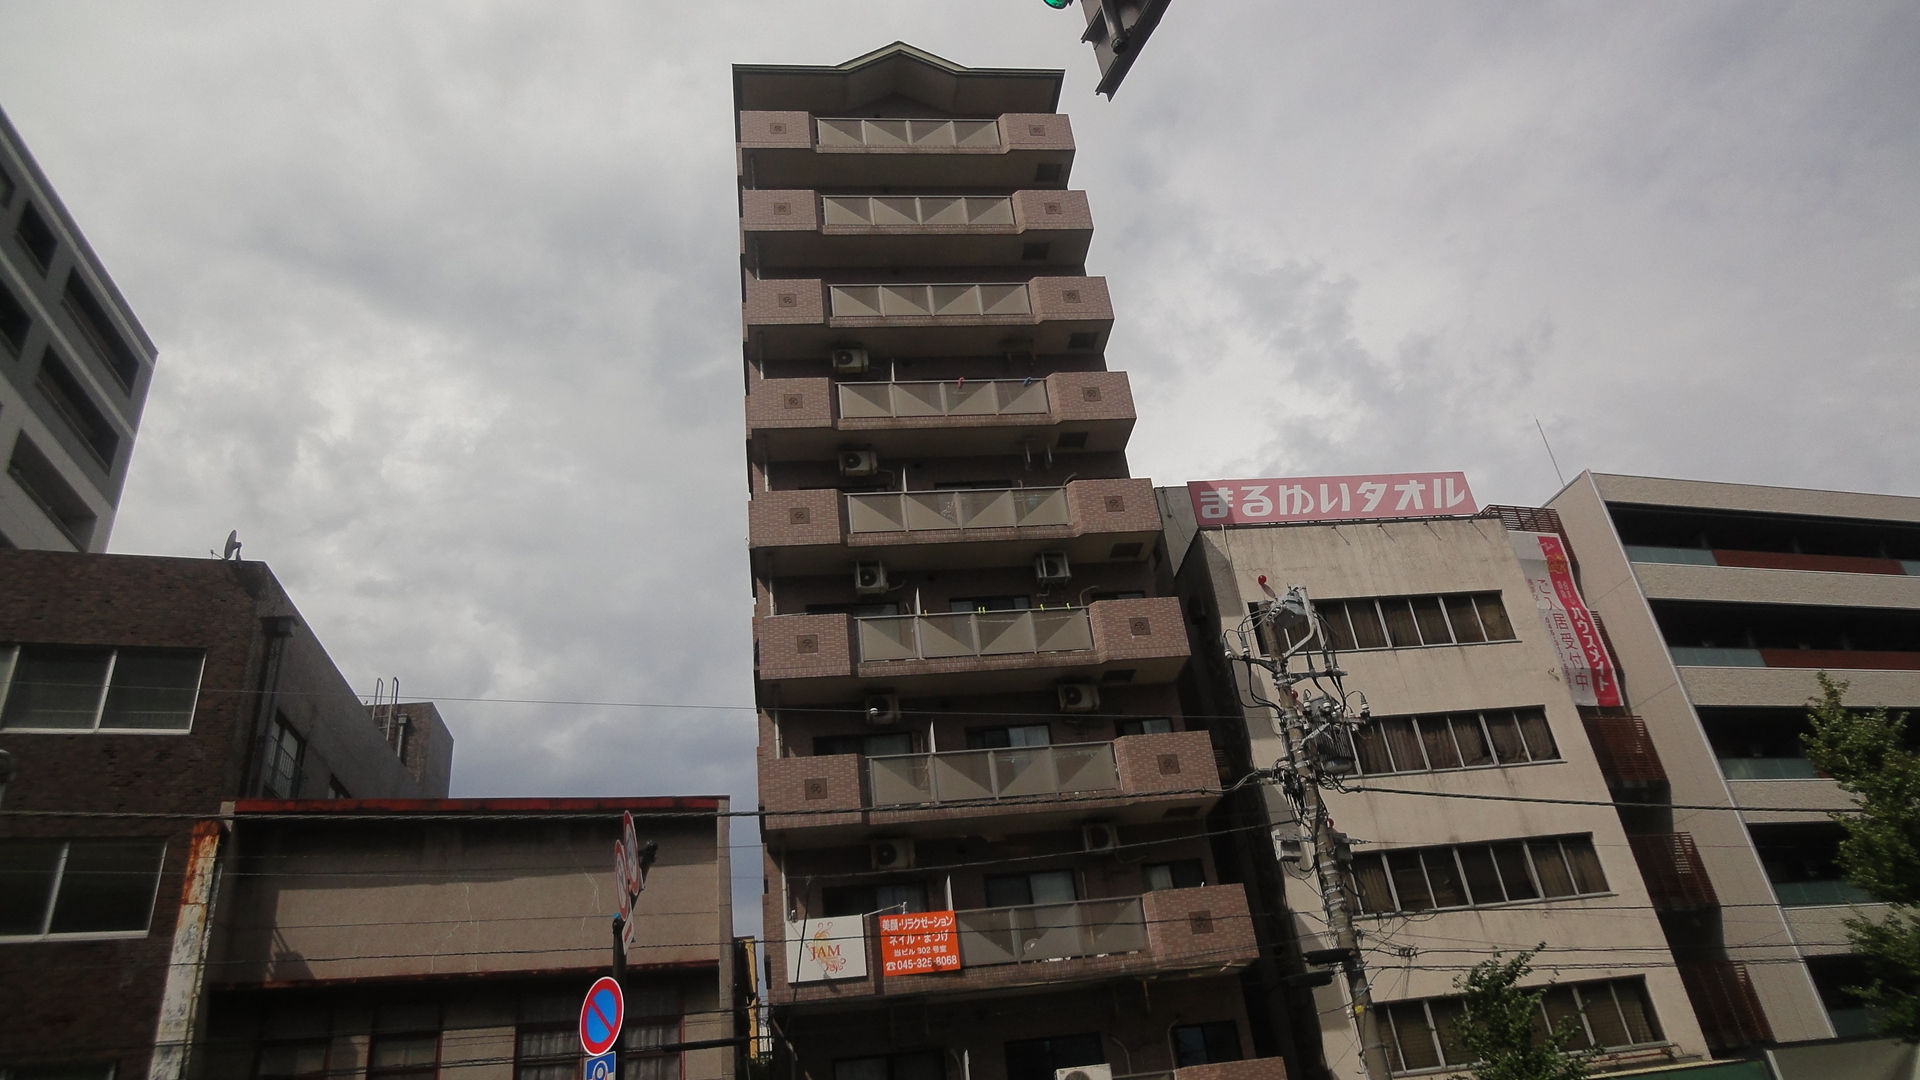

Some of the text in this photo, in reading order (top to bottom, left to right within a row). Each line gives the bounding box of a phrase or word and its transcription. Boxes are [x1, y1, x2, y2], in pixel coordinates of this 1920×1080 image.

[1536, 579, 1589, 691] ご入居受付中
[1571, 606, 1609, 692] ハウスメイト
[810, 944, 841, 961] JAM
[897, 955, 958, 970] 045-325-8068
